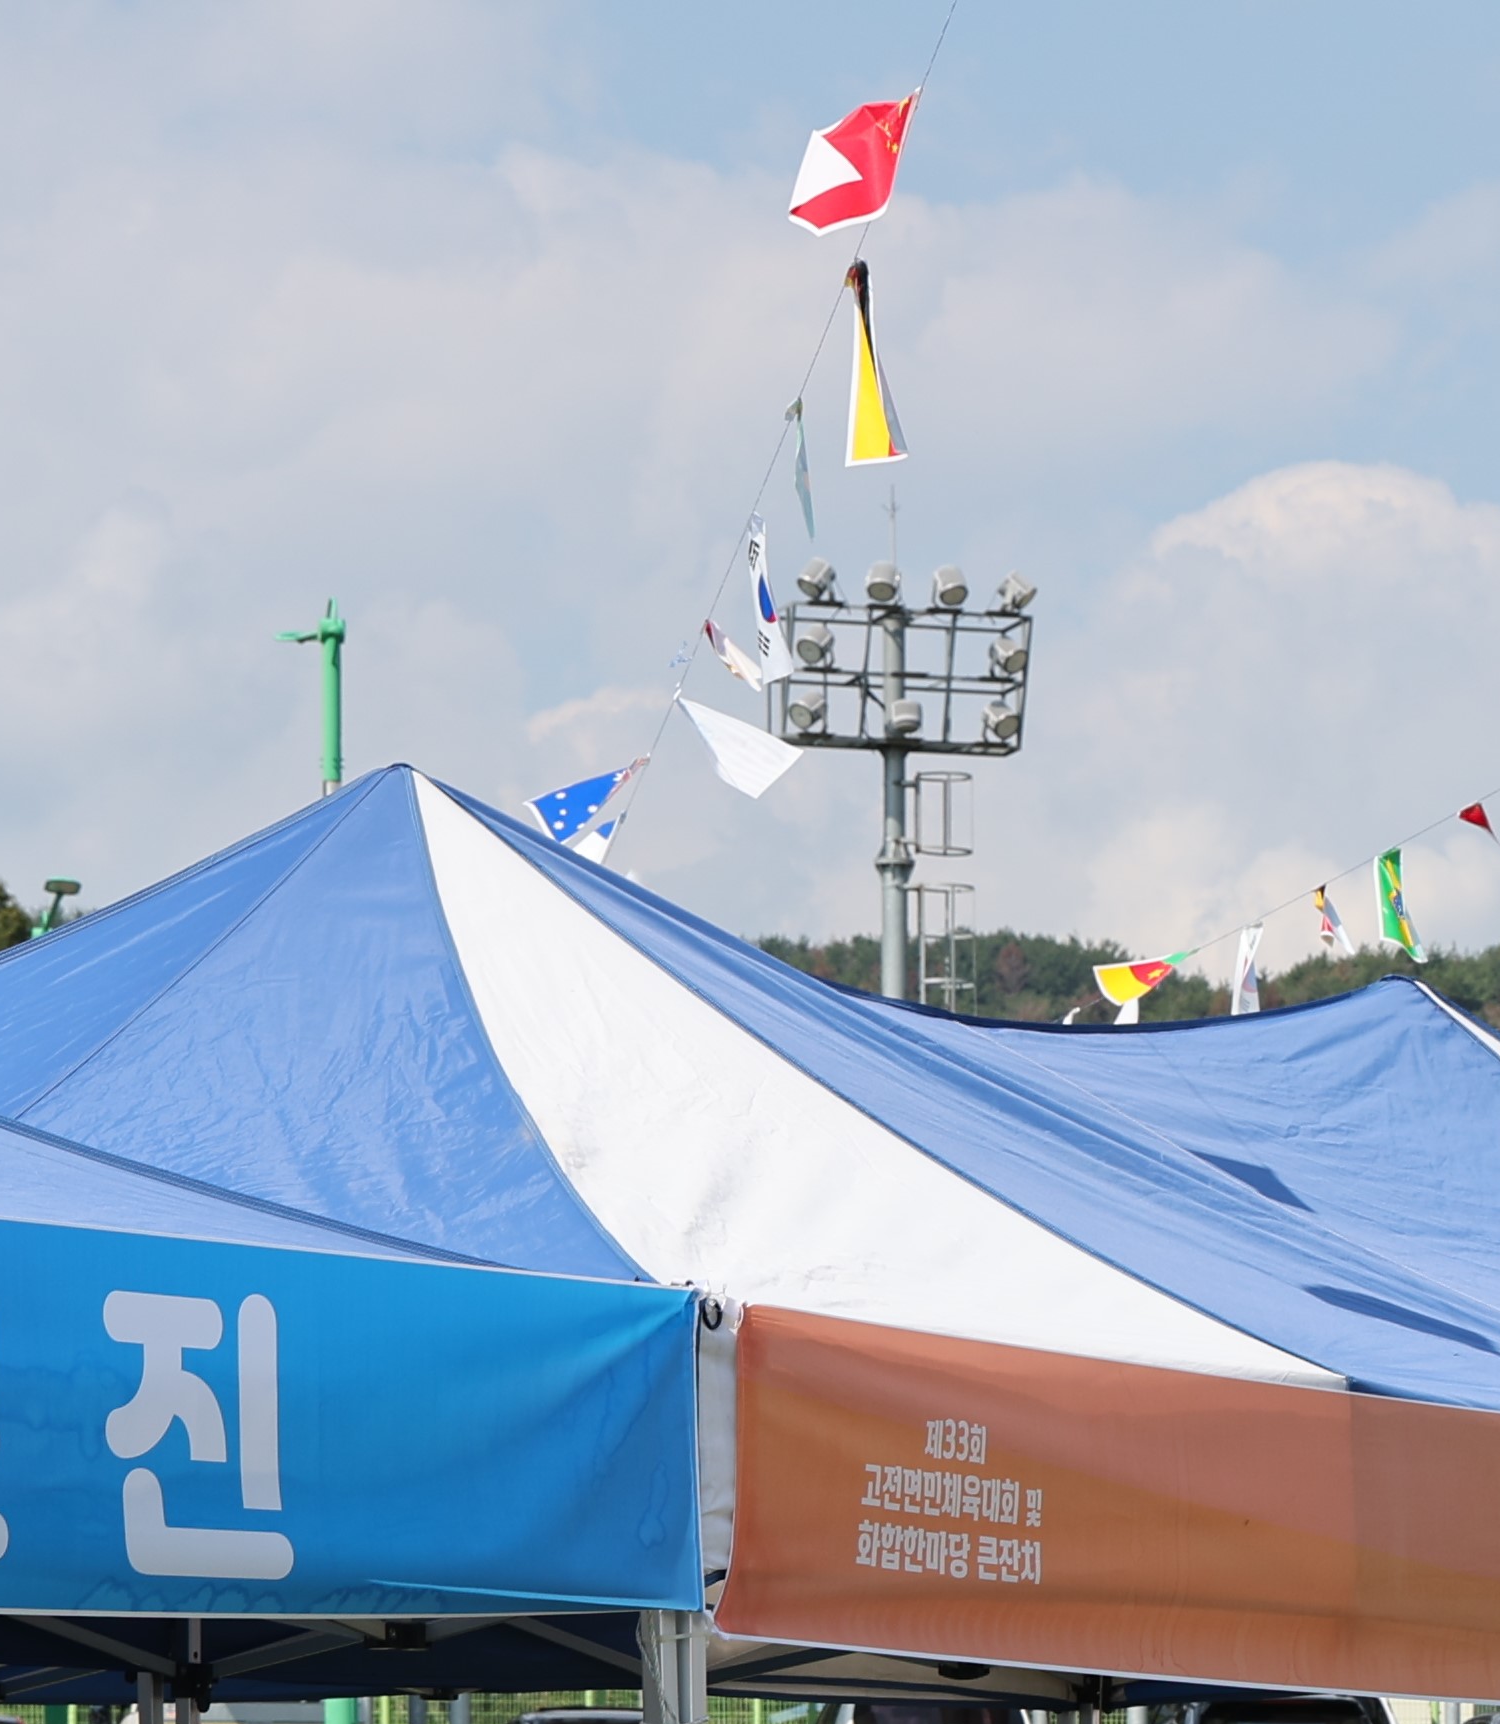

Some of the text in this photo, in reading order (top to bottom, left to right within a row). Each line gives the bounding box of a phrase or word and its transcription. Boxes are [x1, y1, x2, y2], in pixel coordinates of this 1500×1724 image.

[924, 1418, 987, 1465] 제33회
[861, 1463, 1042, 1528] 고전면민체육대회 및
[855, 1519, 1041, 1585] 화합한마당 큰잔치
